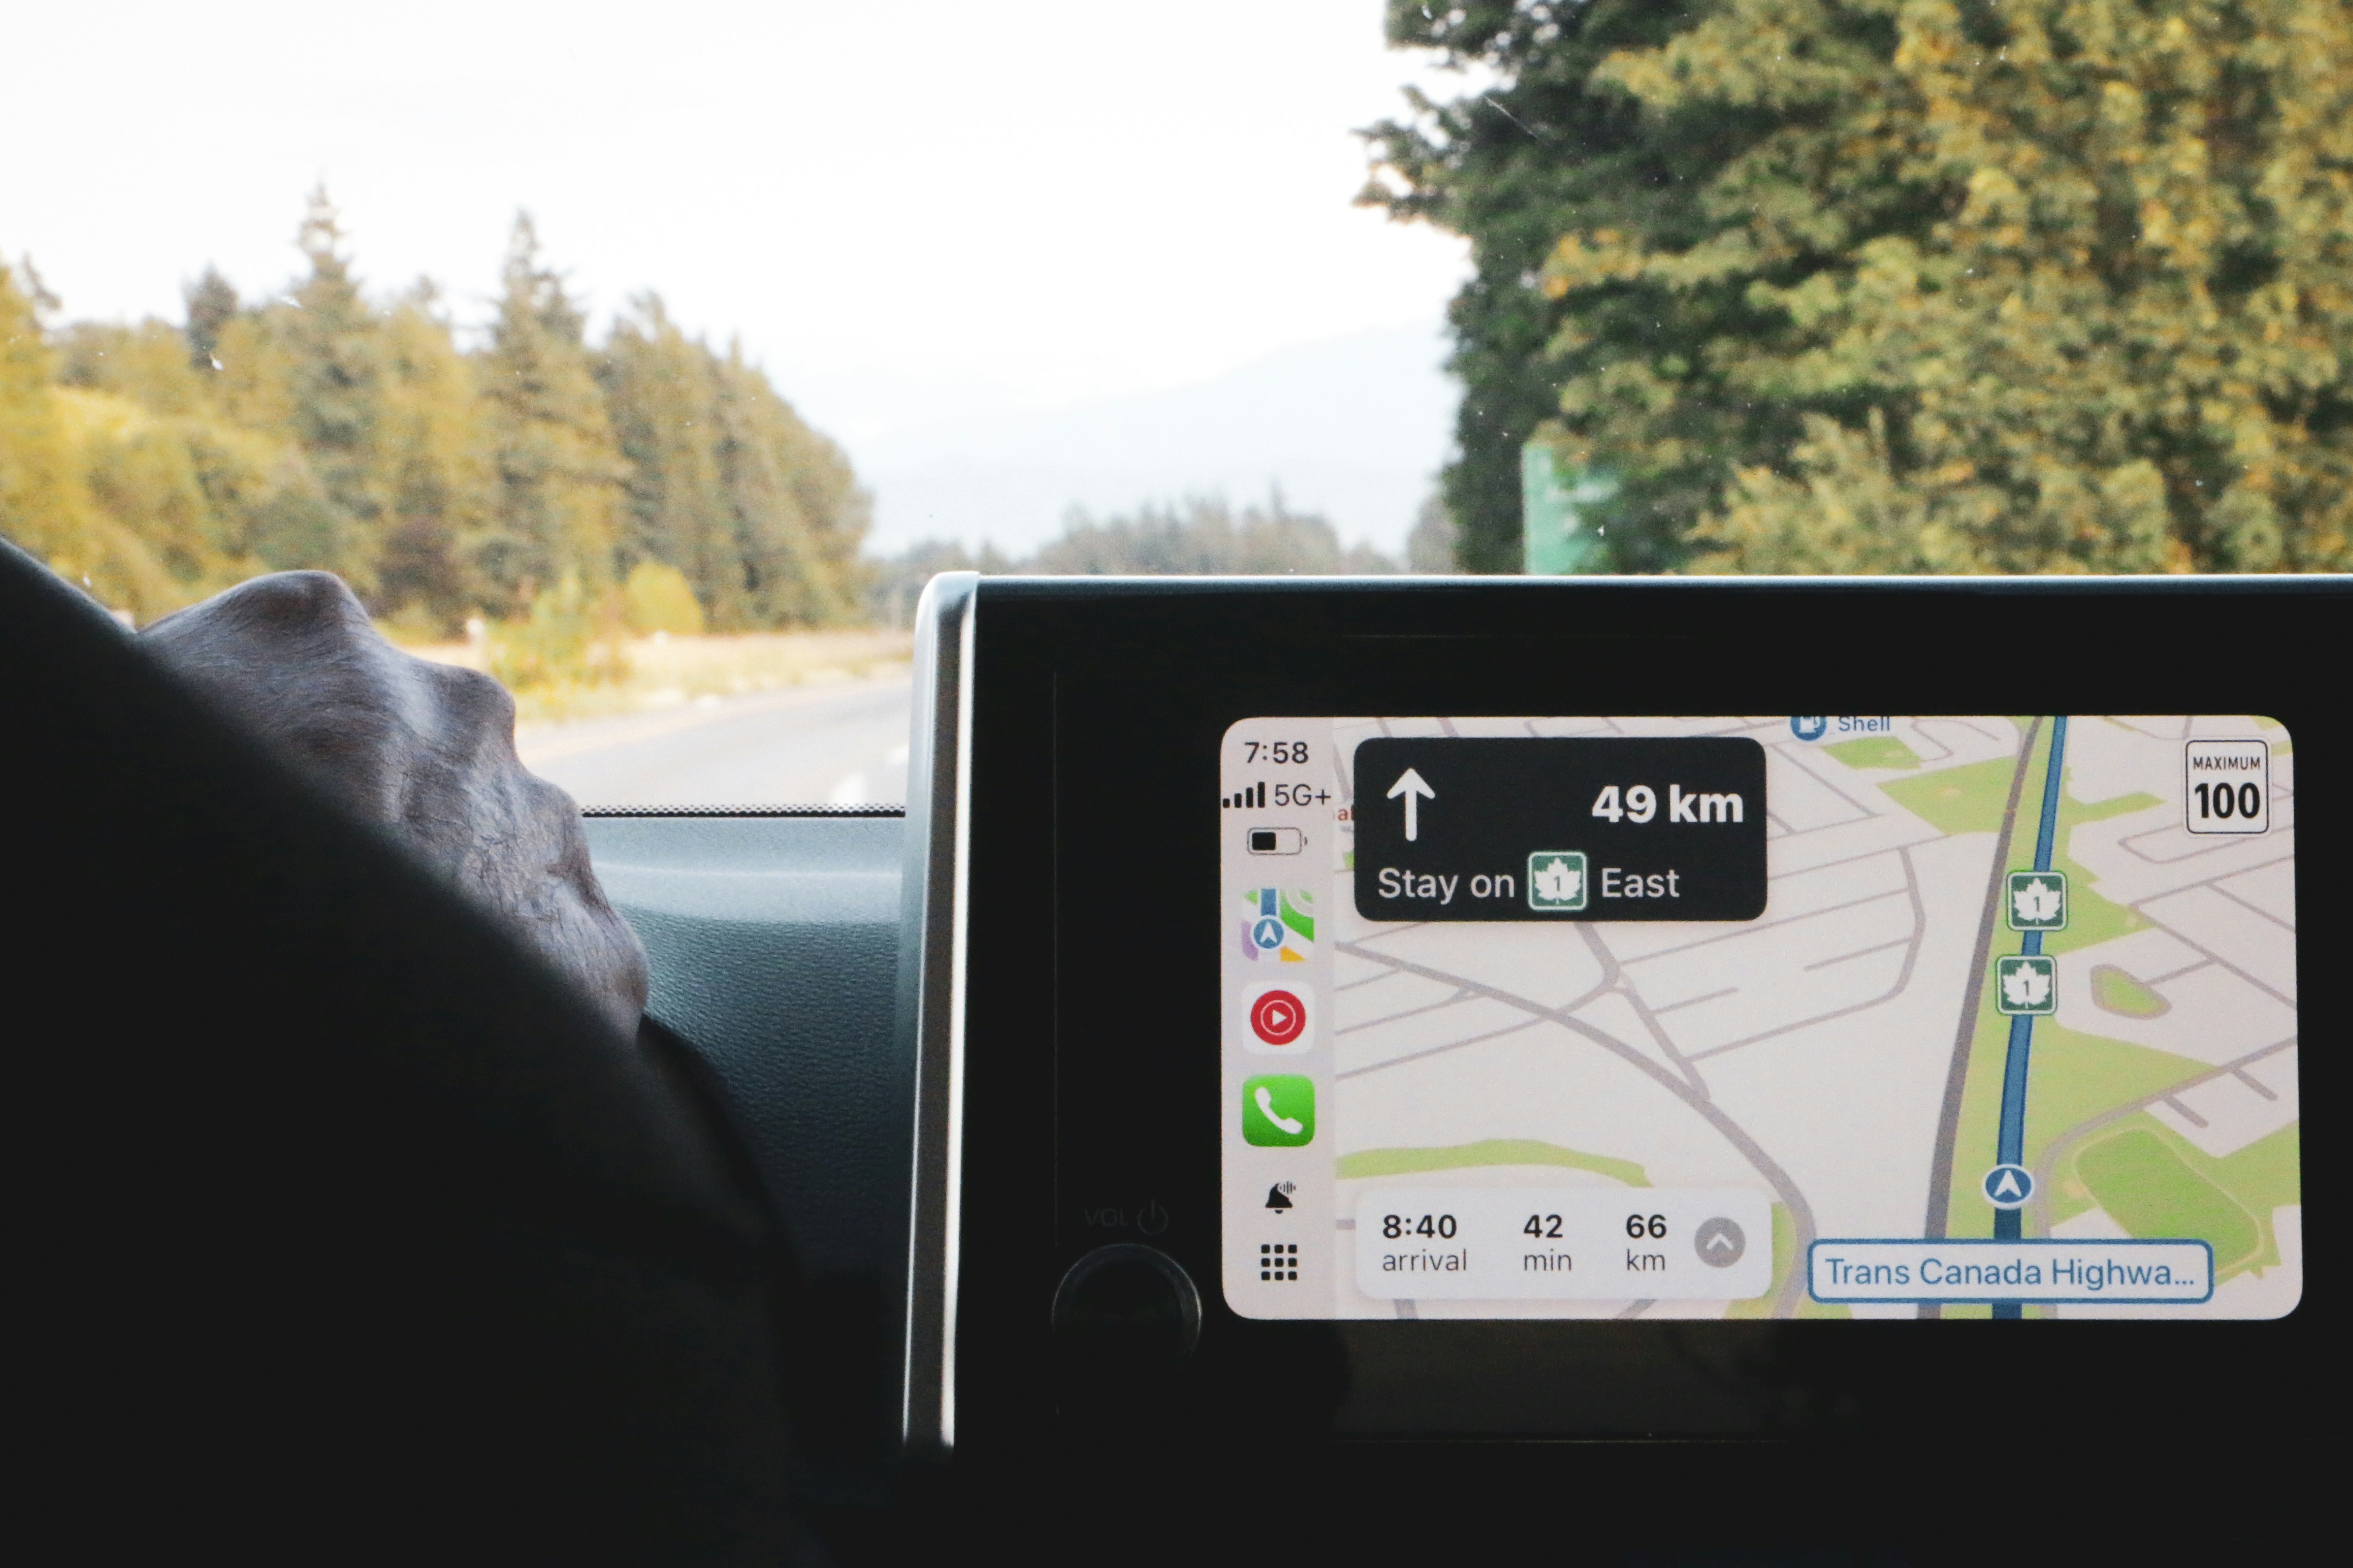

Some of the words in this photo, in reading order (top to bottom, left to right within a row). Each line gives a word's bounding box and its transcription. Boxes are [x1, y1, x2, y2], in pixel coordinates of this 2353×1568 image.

[1838, 716, 1890, 731] Shell
[1244, 741, 1309, 765] 7:58
[2193, 756, 2260, 770] MAXIMUM
[1274, 784, 1331, 807] 5G+
[1592, 785, 1657, 823] 49
[1669, 784, 1744, 823] km
[2194, 782, 2260, 819] 100
[1378, 867, 1458, 905] Stay
[1470, 875, 1515, 898] on
[1553, 875, 1561, 892] 1
[1601, 867, 1680, 898] East
[2033, 896, 2040, 912] 1
[2023, 979, 2030, 996] 1
[1085, 1208, 1129, 1227] VOL
[1382, 1214, 1457, 1239] 8:40
[1523, 1214, 1563, 1239] 42
[1626, 1214, 1667, 1239] 66
[1382, 1248, 1467, 1271] arrival
[1523, 1248, 1572, 1271] min
[1626, 1248, 1665, 1271] km
[1825, 1258, 1910, 1285] Trans
[1920, 1258, 2042, 1285] Canada
[2052, 1258, 2194, 1292] Highwa...
